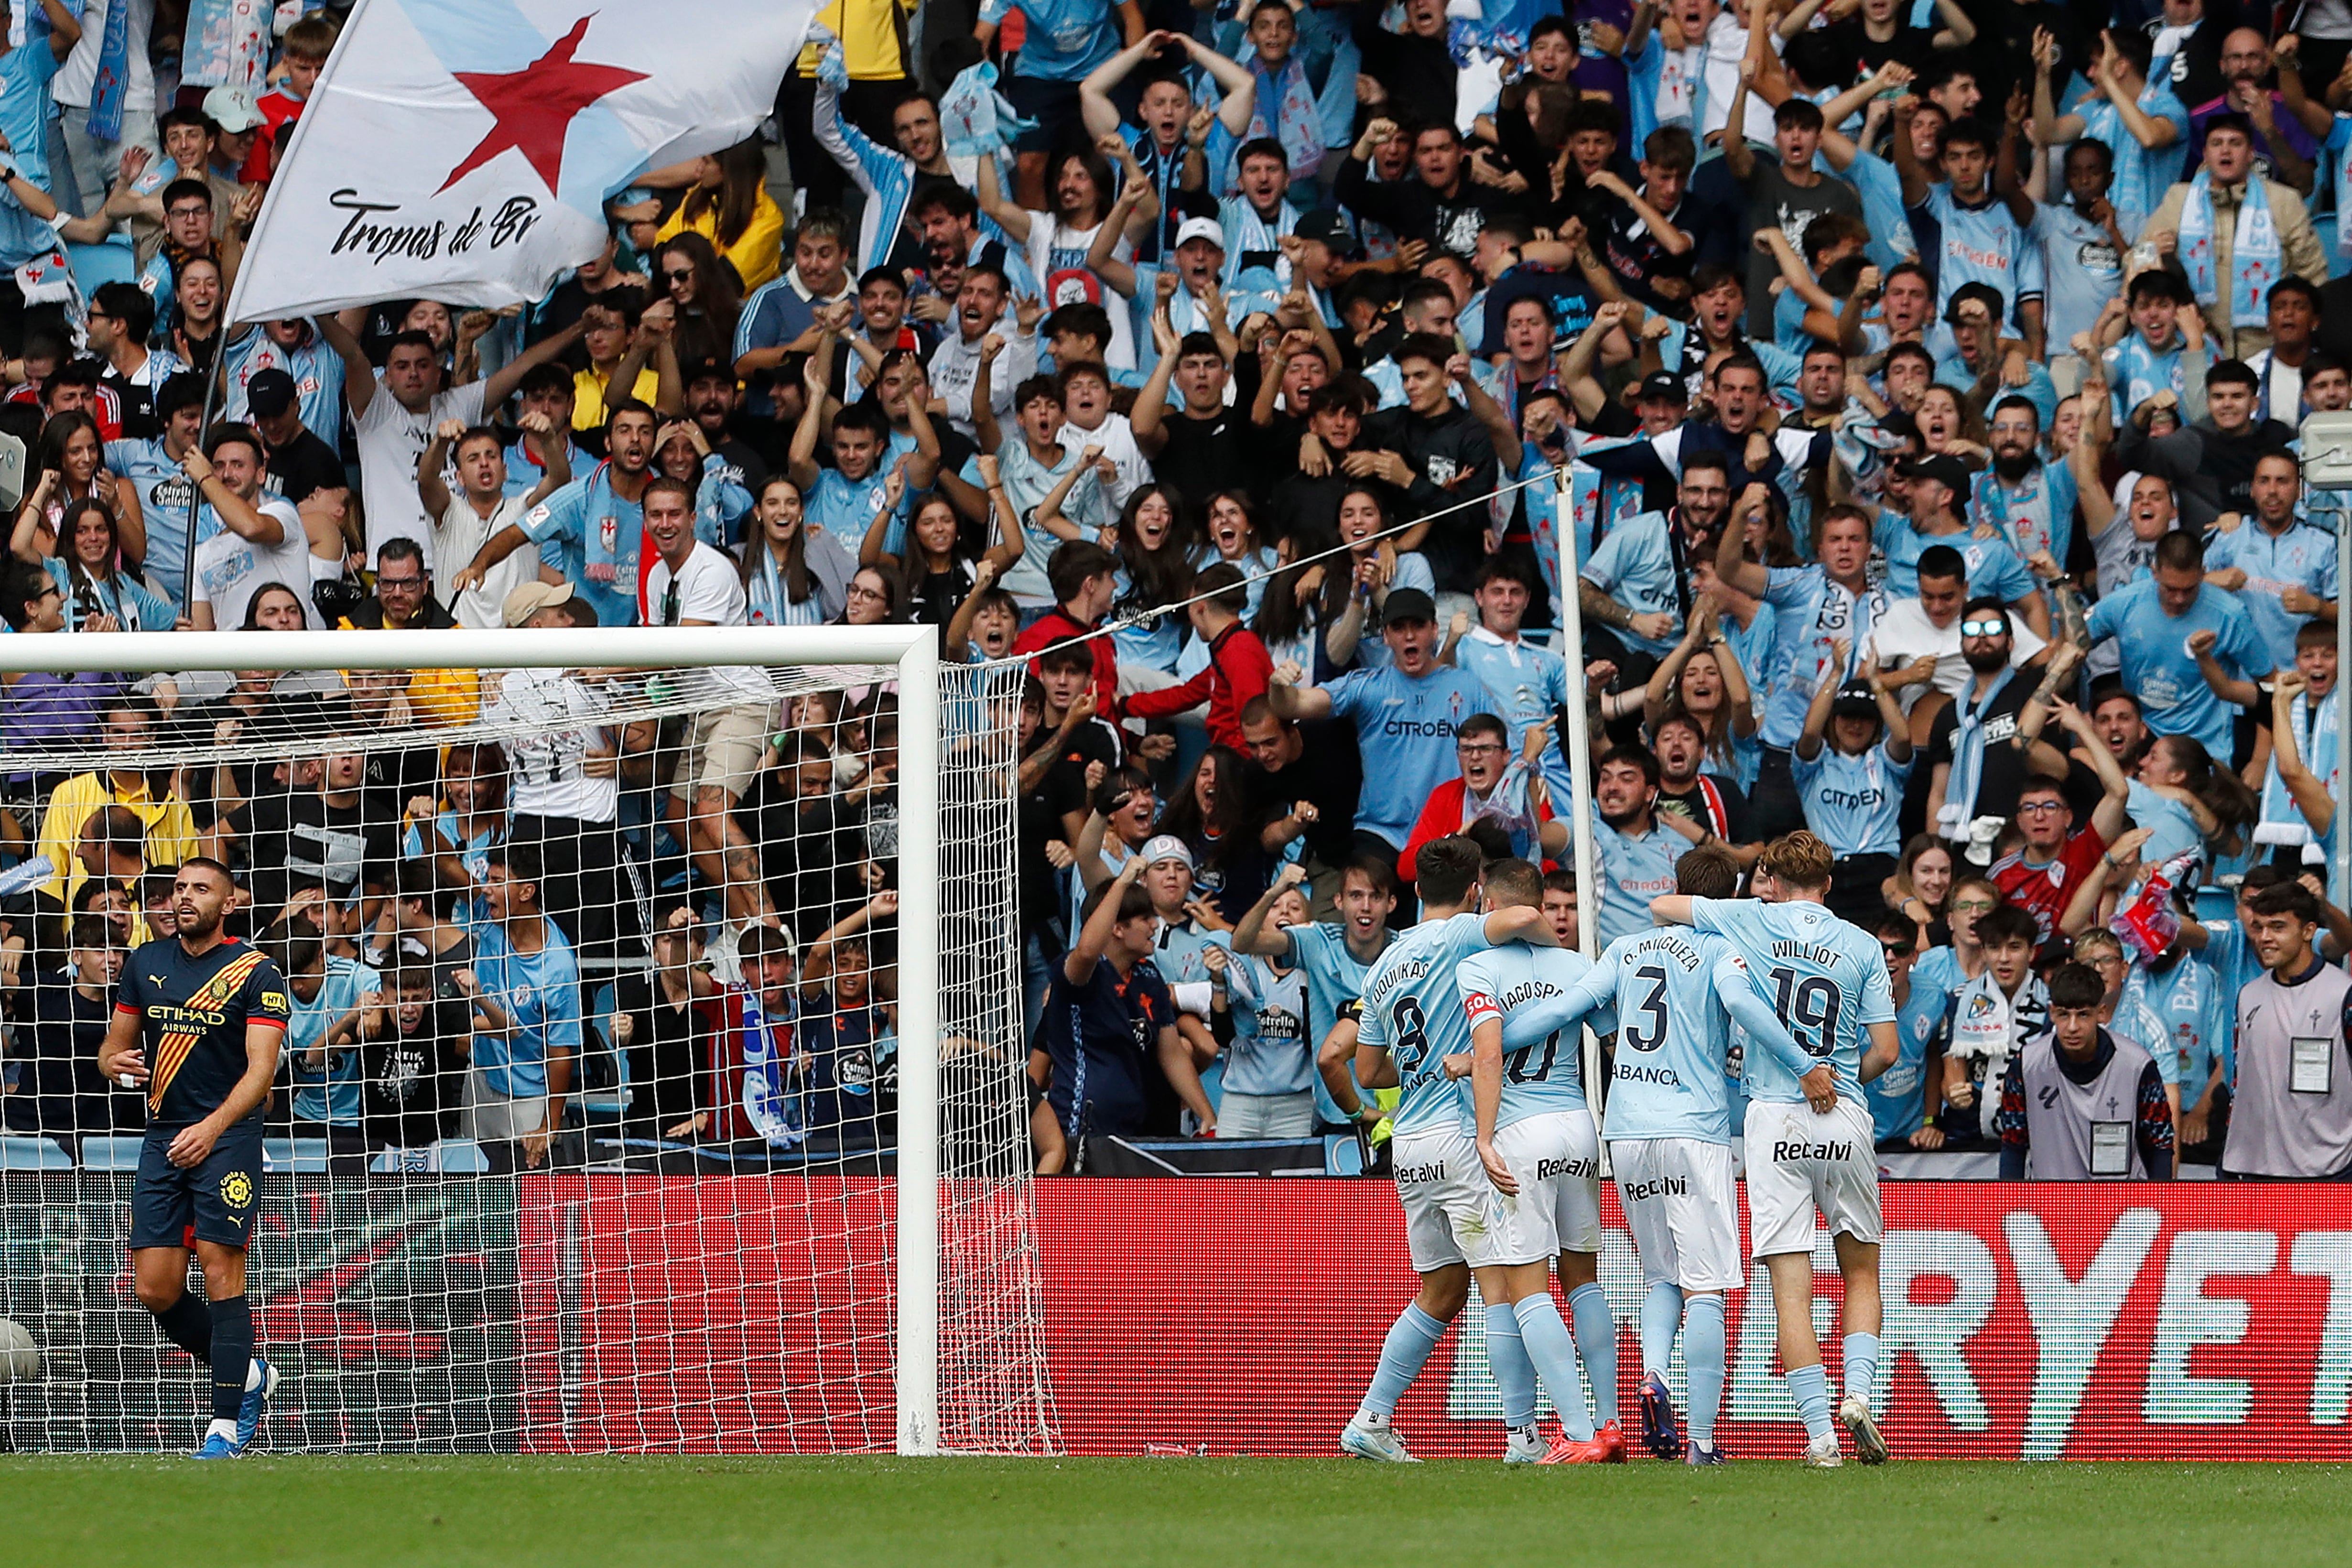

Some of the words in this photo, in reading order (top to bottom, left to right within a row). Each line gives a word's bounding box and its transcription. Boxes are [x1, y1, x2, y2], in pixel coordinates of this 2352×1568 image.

[331, 190, 447, 265] Tropas
[448, 205, 485, 258] de
[1385, 718, 1459, 737] CITROËN
[1624, 953, 1637, 965] O.
[1639, 937, 1700, 972] MIGUEZA
[1772, 941, 1841, 968] WILLIOT
[148, 1006, 224, 1026] ETIHAD
[1626, 966, 1667, 1052] 3
[1769, 968, 1841, 1057] 19
[162, 1023, 207, 1035] AIRWAYS
[1393, 997, 1429, 1071] 9
[1774, 1141, 1852, 1162] Recalvi
[1394, 1160, 1445, 1183] Recalvi
